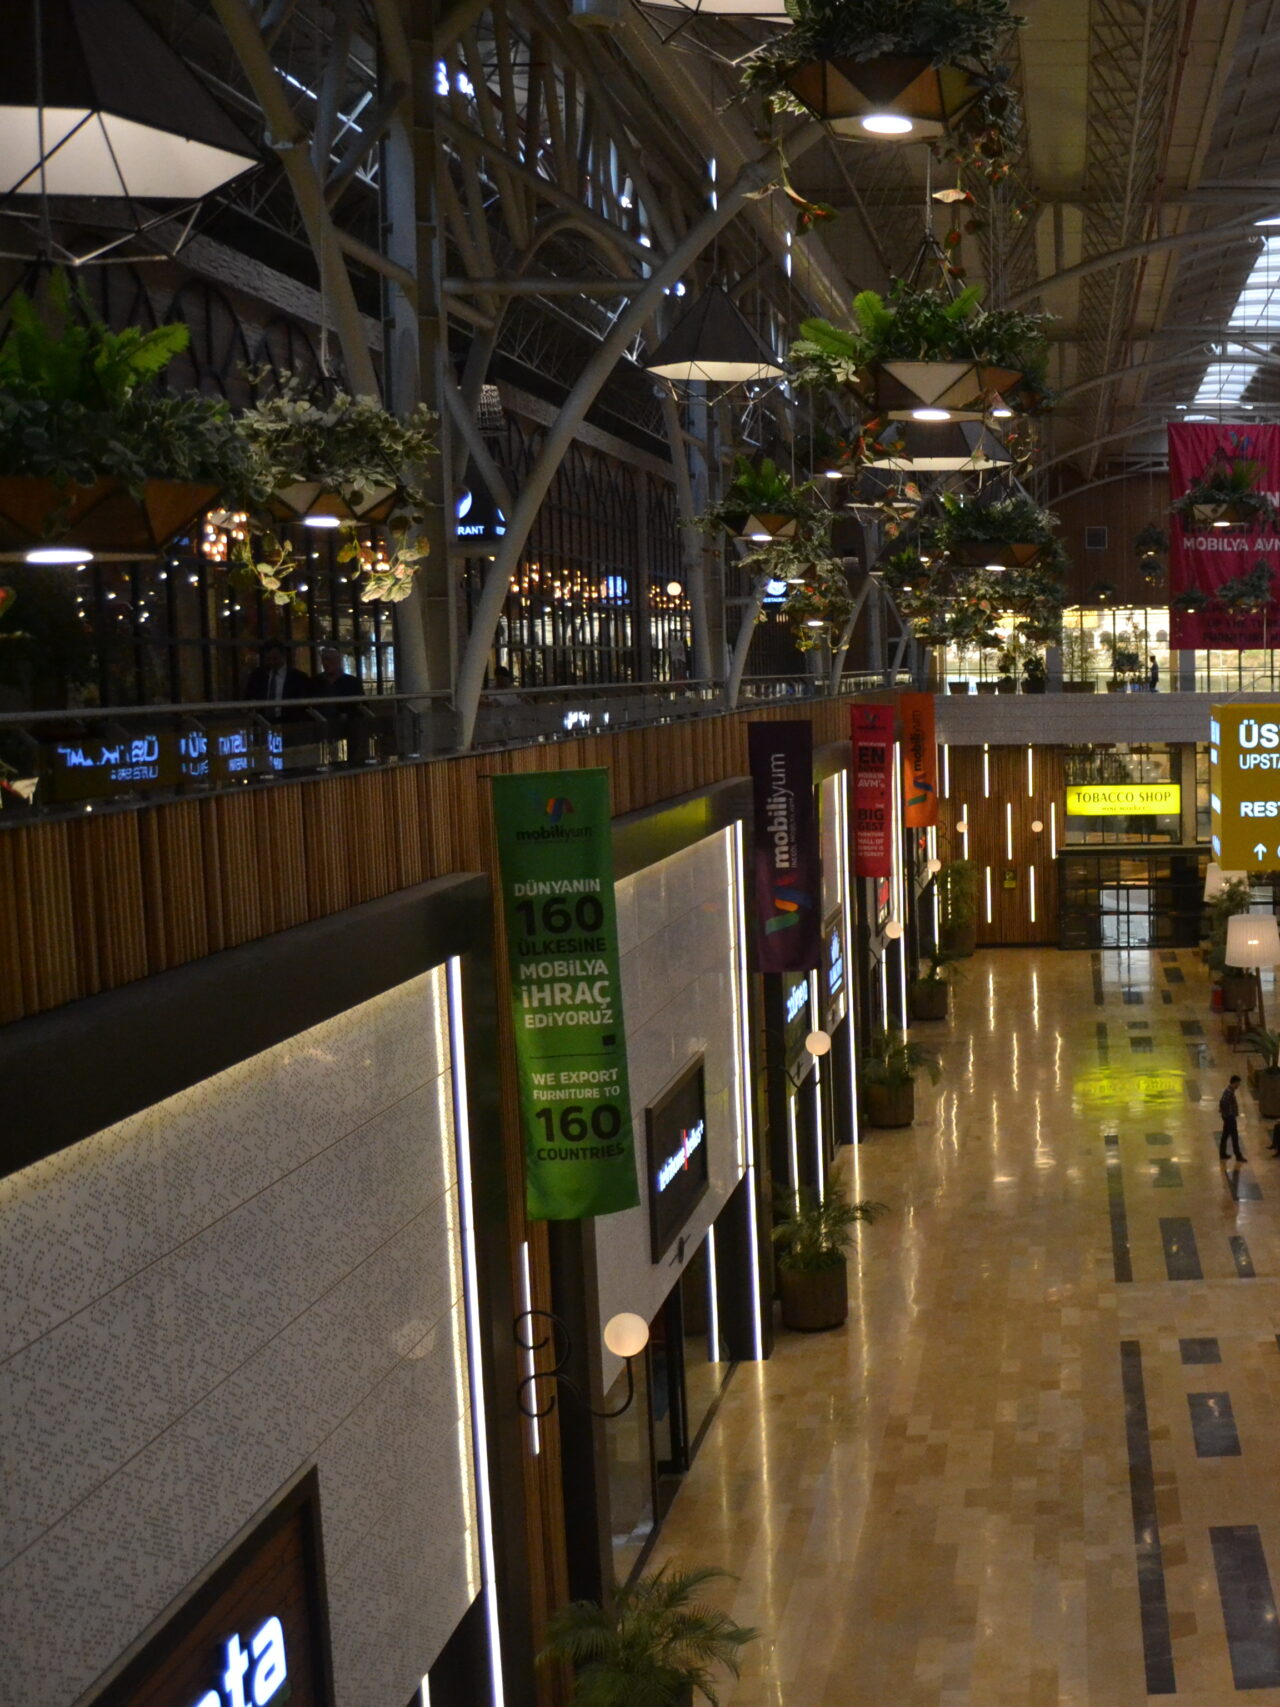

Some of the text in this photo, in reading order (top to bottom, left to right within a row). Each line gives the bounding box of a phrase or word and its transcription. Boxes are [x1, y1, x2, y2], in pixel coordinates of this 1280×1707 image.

[1075, 791, 1172, 804] TOBACCO SHOP
[766, 752, 796, 869] mobiliyum
[516, 824, 593, 842] mobiliyum
[514, 878, 601, 897] DÜNYANIN
[516, 895, 604, 937] 160
[532, 1068, 619, 1086] WE EXPORT
[533, 1085, 621, 1101] FURNITURE TO
[535, 1103, 622, 1143] 160
[537, 1142, 625, 1161] COUNTRIES
[194, 1615, 288, 1707] ta
